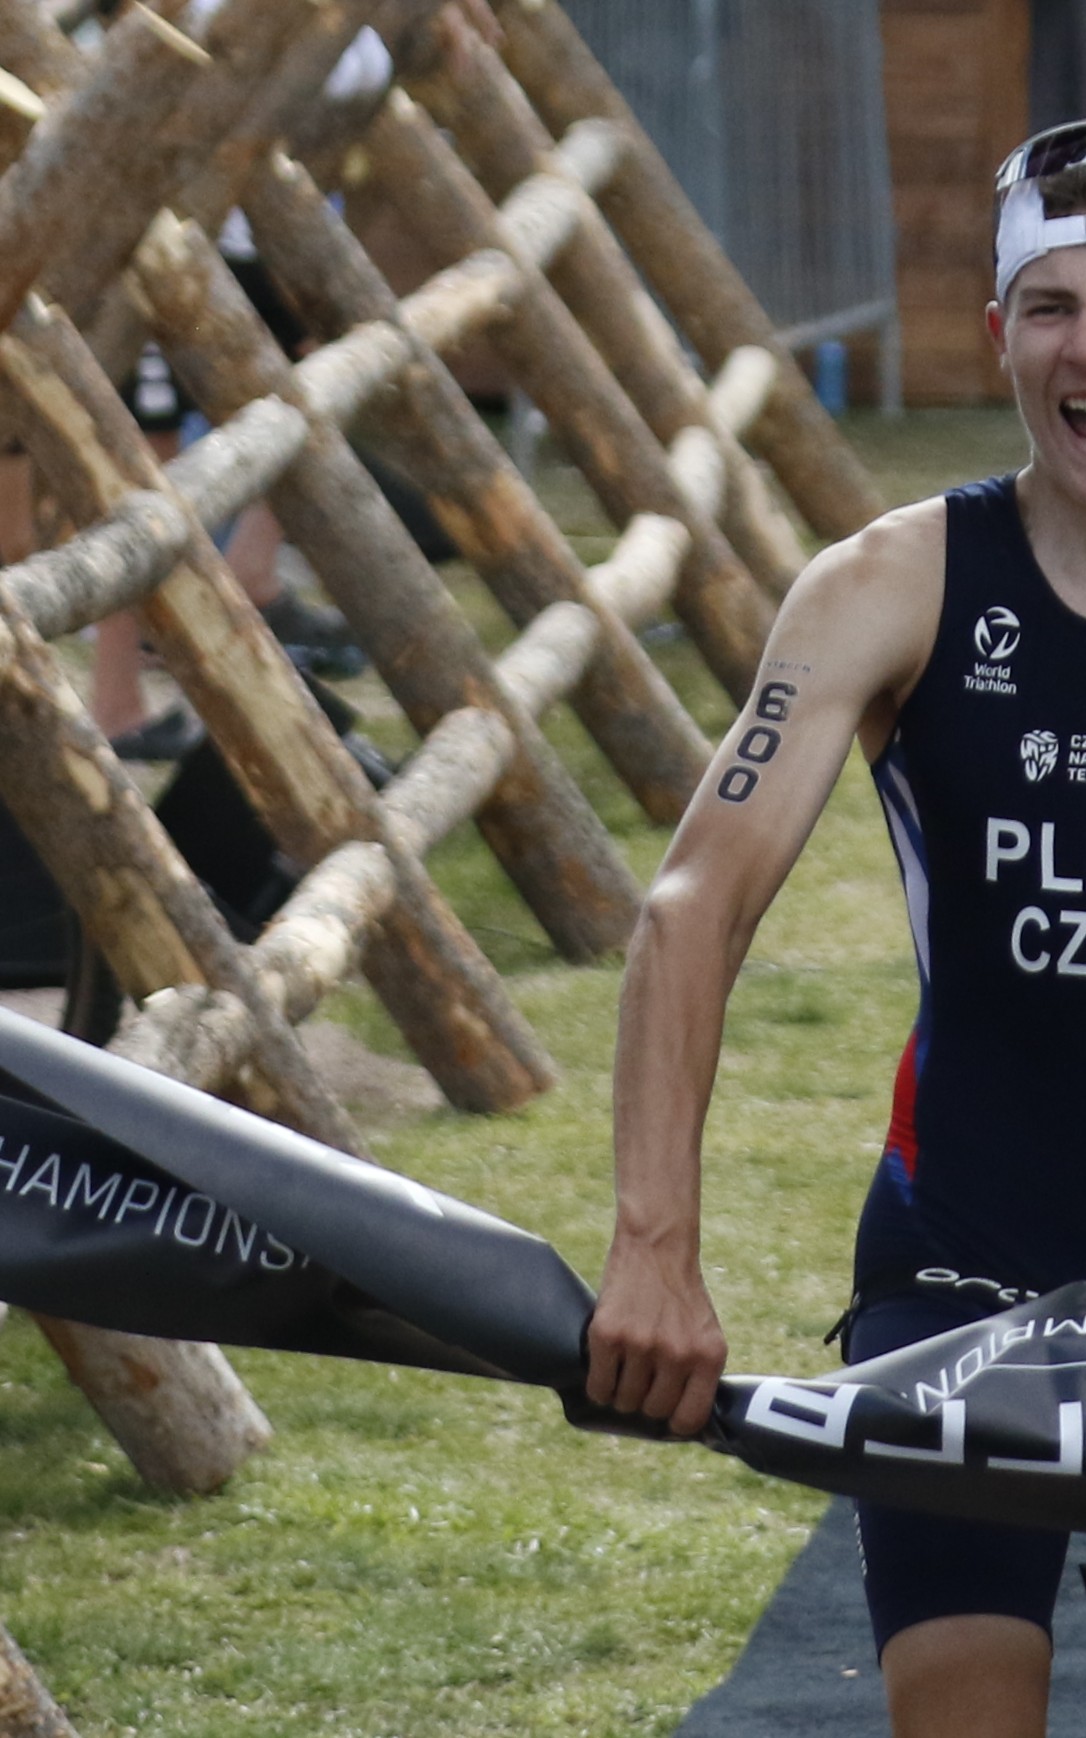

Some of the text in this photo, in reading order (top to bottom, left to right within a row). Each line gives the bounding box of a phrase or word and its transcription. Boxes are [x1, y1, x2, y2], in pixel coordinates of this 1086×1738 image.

[963, 675, 1017, 694] Triathlon
[973, 662, 1011, 680] World
[717, 680, 798, 803] 600
[0, 1136, 310, 1270] HAMPIONS
